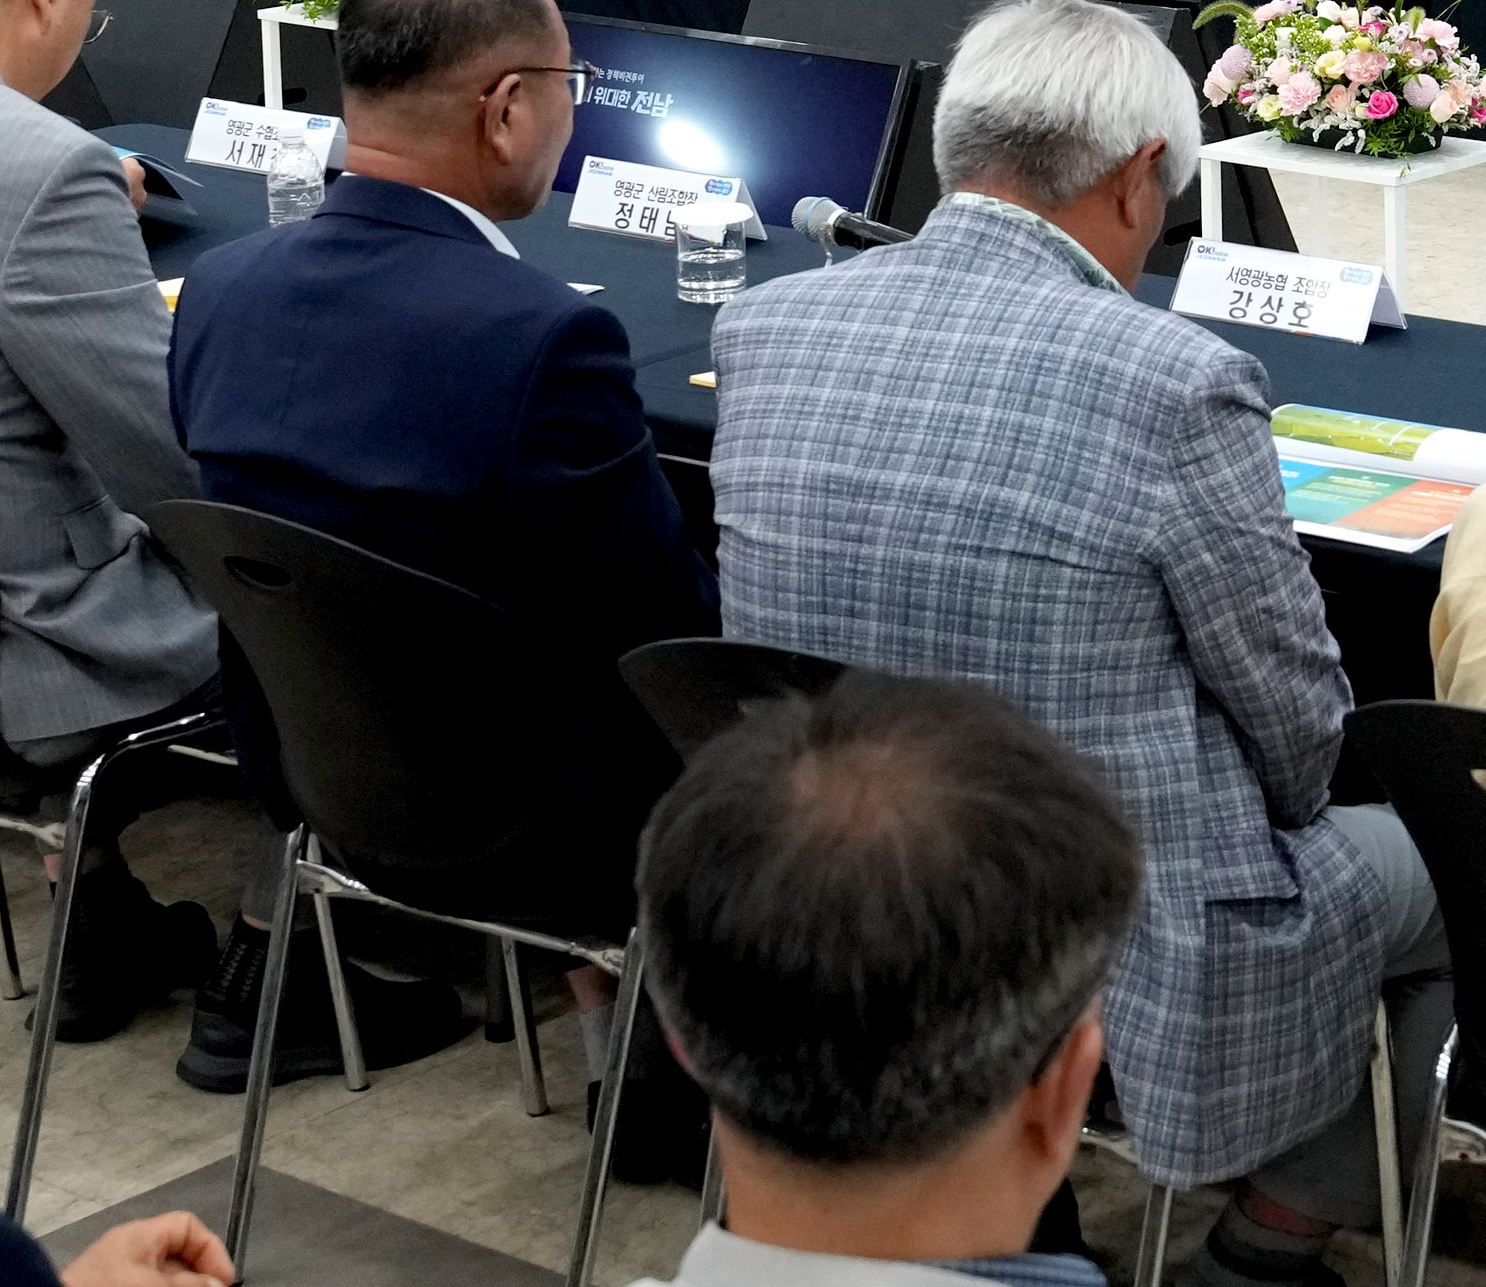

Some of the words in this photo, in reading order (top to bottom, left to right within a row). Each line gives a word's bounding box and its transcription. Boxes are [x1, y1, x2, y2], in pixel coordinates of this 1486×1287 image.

[593, 86, 631, 109] 위대한
[631, 90, 674, 118] 전남
[226, 119, 254, 137] 영광군
[225, 140, 279, 169] 서재
[614, 179, 645, 200] 영광군
[1226, 266, 1288, 291] 서영광농협
[1292, 275, 1331, 299] 조합장
[1228, 289, 1314, 329] 강상호
